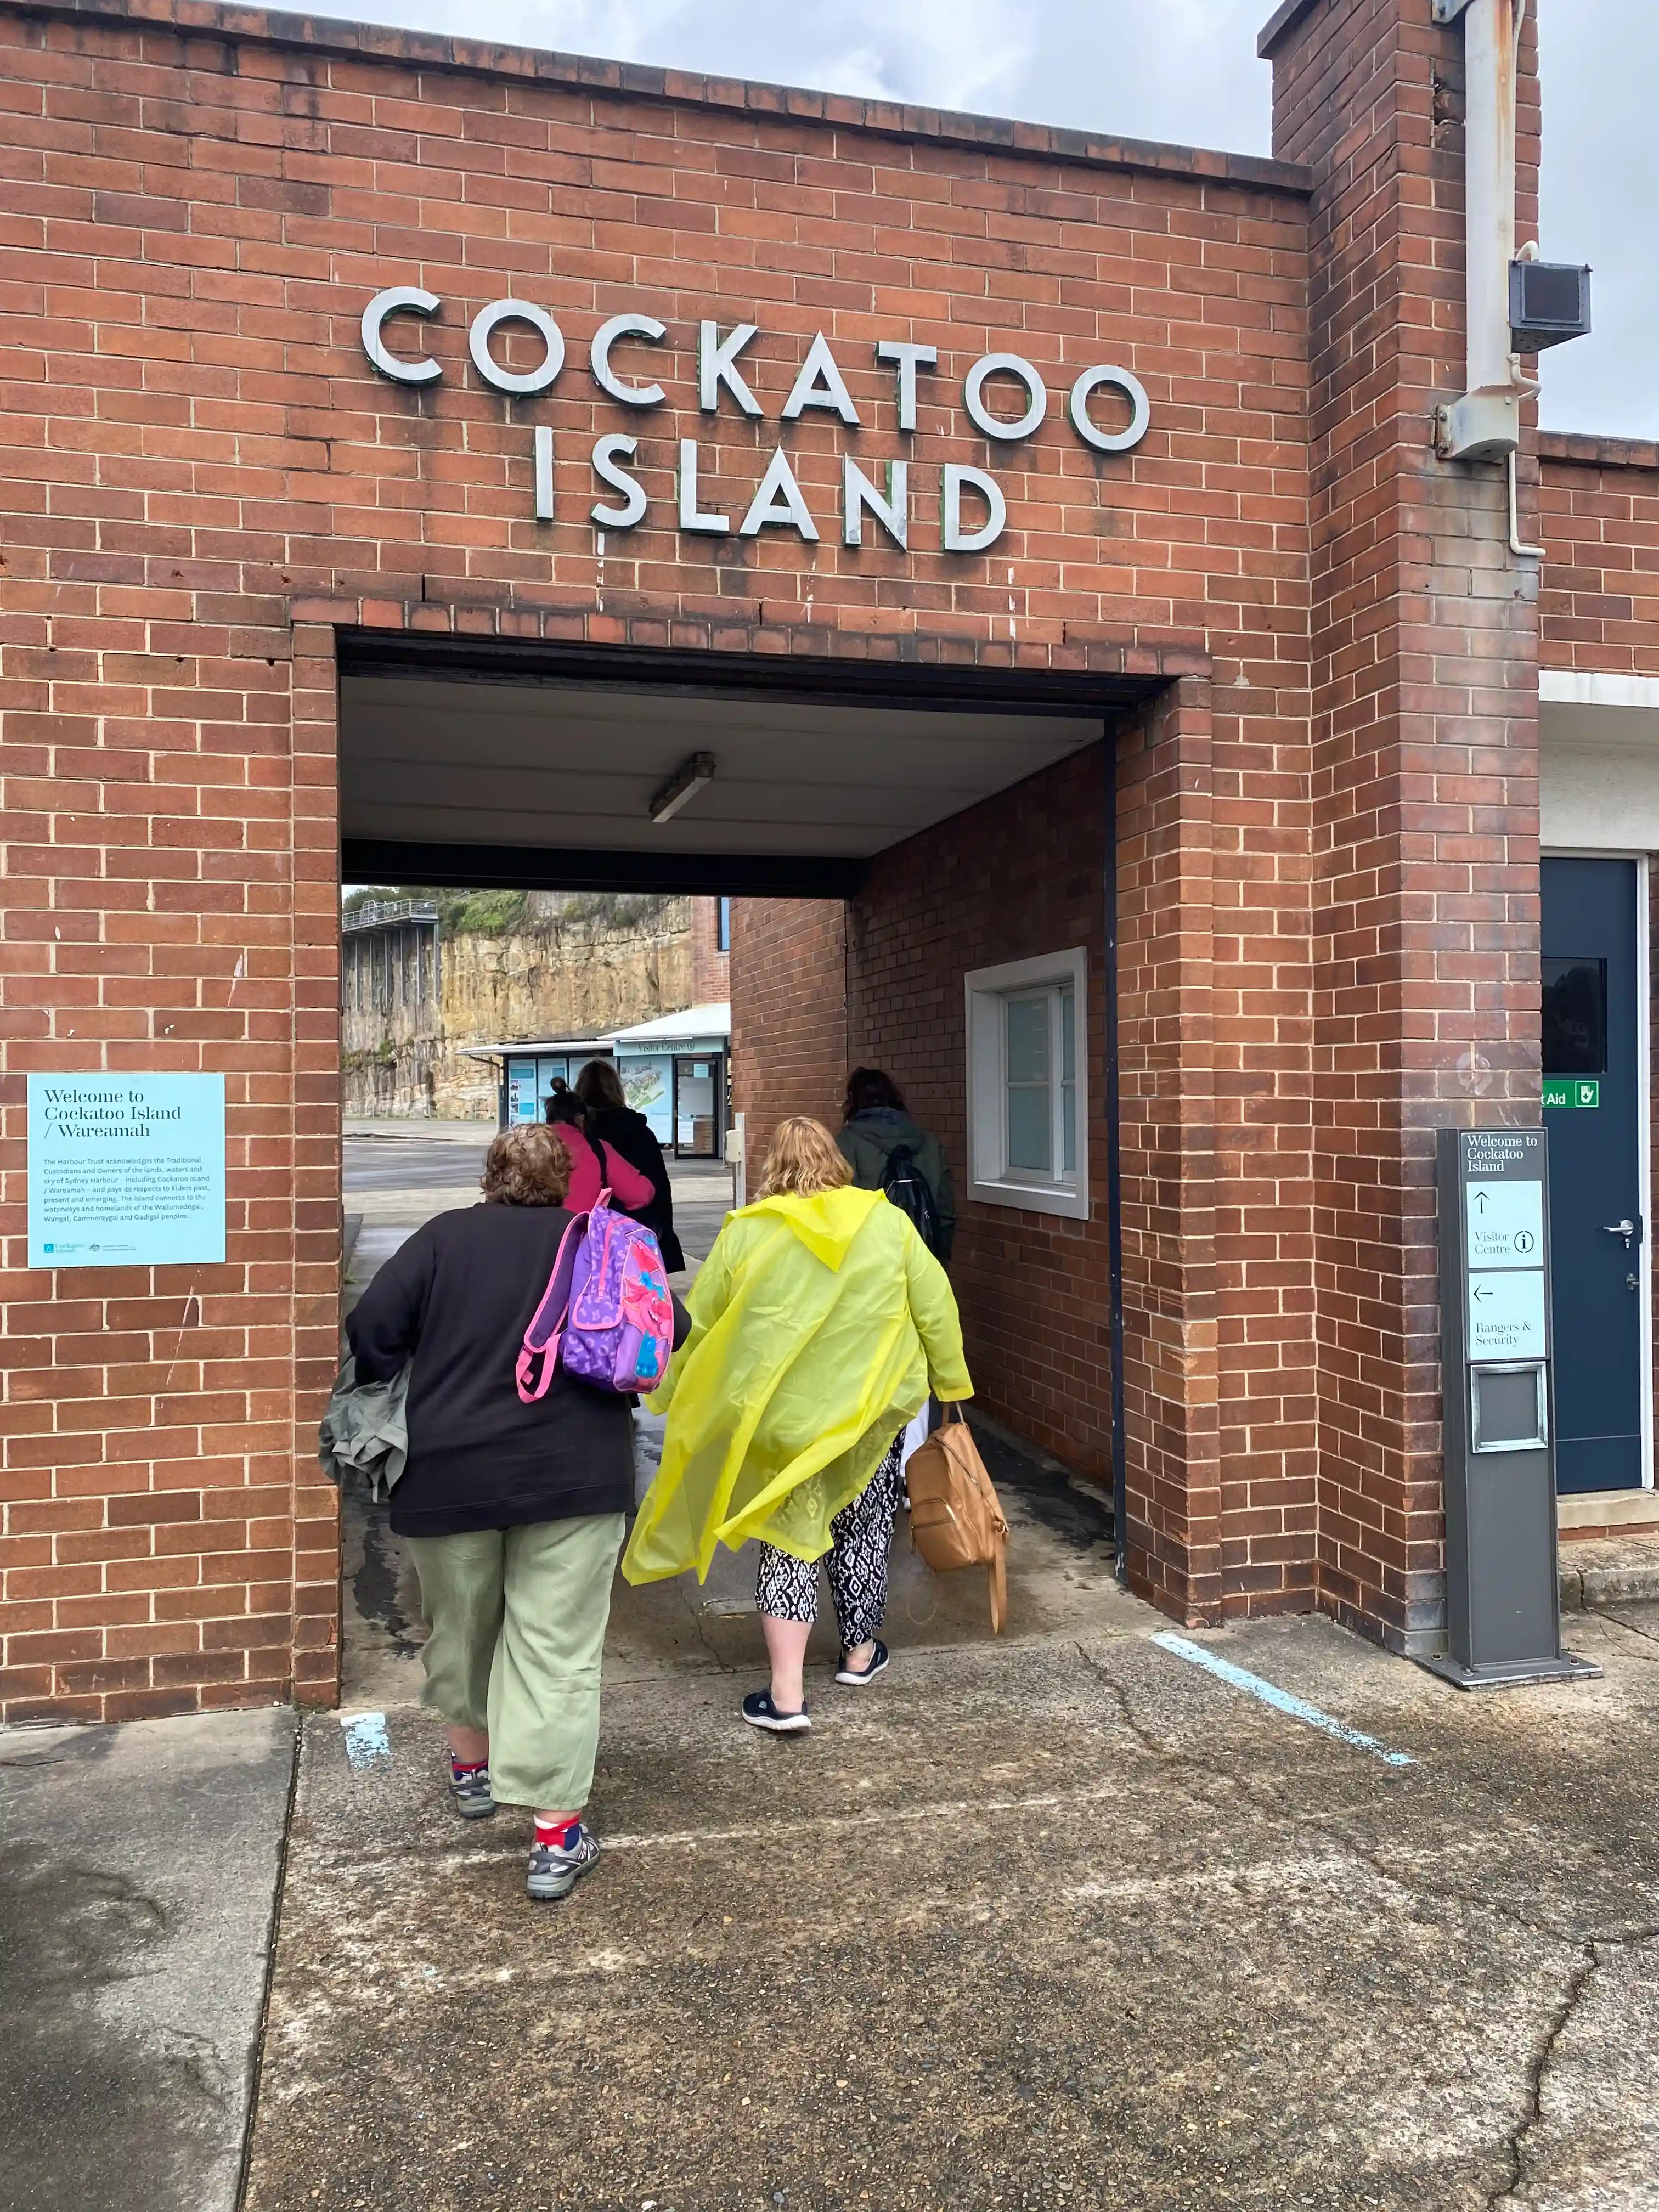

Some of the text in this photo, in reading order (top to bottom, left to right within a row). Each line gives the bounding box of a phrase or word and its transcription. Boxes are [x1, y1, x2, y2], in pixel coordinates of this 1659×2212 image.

[361, 285, 1152, 454] COCKATOO
[532, 424, 1008, 554] ISLAND
[638, 1041, 685, 1052] Visitor Centre
[44, 1090, 144, 1103] Welcome to
[1547, 1093, 1566, 1105] Aid
[44, 1106, 182, 1120] Cockatoo Island
[43, 1122, 150, 1139] / Wareamah
[1466, 1135, 1538, 1147] Welcome to
[1467, 1147, 1523, 1159] Cockatoo
[106, 1157, 152, 1165] acknowledges
[1467, 1160, 1505, 1172] Island
[44, 1177, 55, 1186] sky
[65, 1177, 88, 1186] Sydney
[126, 1176, 156, 1184] including
[133, 1186, 161, 1194] respects
[44, 1197, 69, 1205] present
[44, 1206, 80, 1214] waterways
[73, 1215, 118, 1223] Cammeraygal
[134, 1214, 159, 1222] Gadigal
[1475, 1231, 1510, 1242] Visitor
[1475, 1244, 1510, 1255] Centre
[1476, 1322, 1532, 1335] Rangers &
[1476, 1334, 1519, 1347] Security
